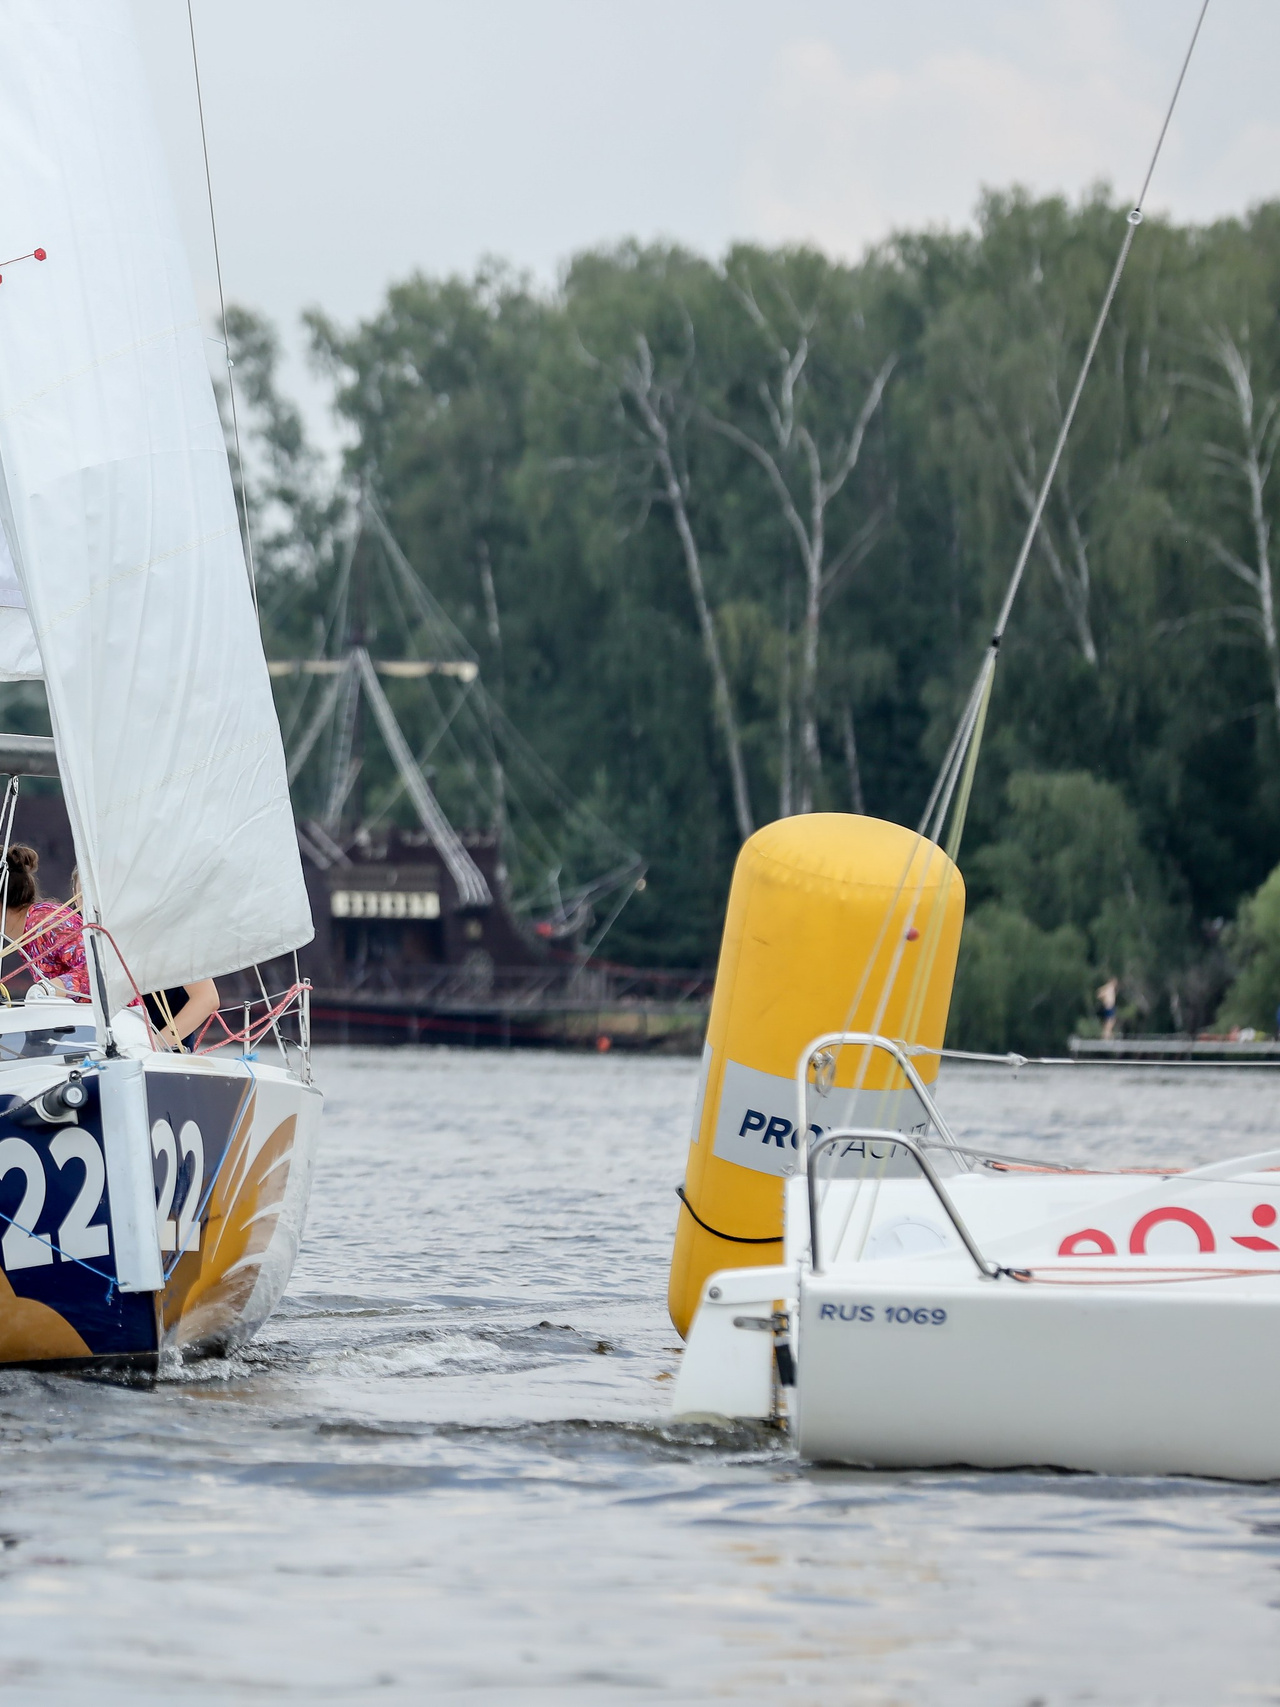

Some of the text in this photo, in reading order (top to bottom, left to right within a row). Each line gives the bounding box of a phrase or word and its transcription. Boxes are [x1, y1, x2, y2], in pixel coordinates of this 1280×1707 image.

[151, 1118, 205, 1251] 22
[820, 1304, 948, 1326] RUS 1069
